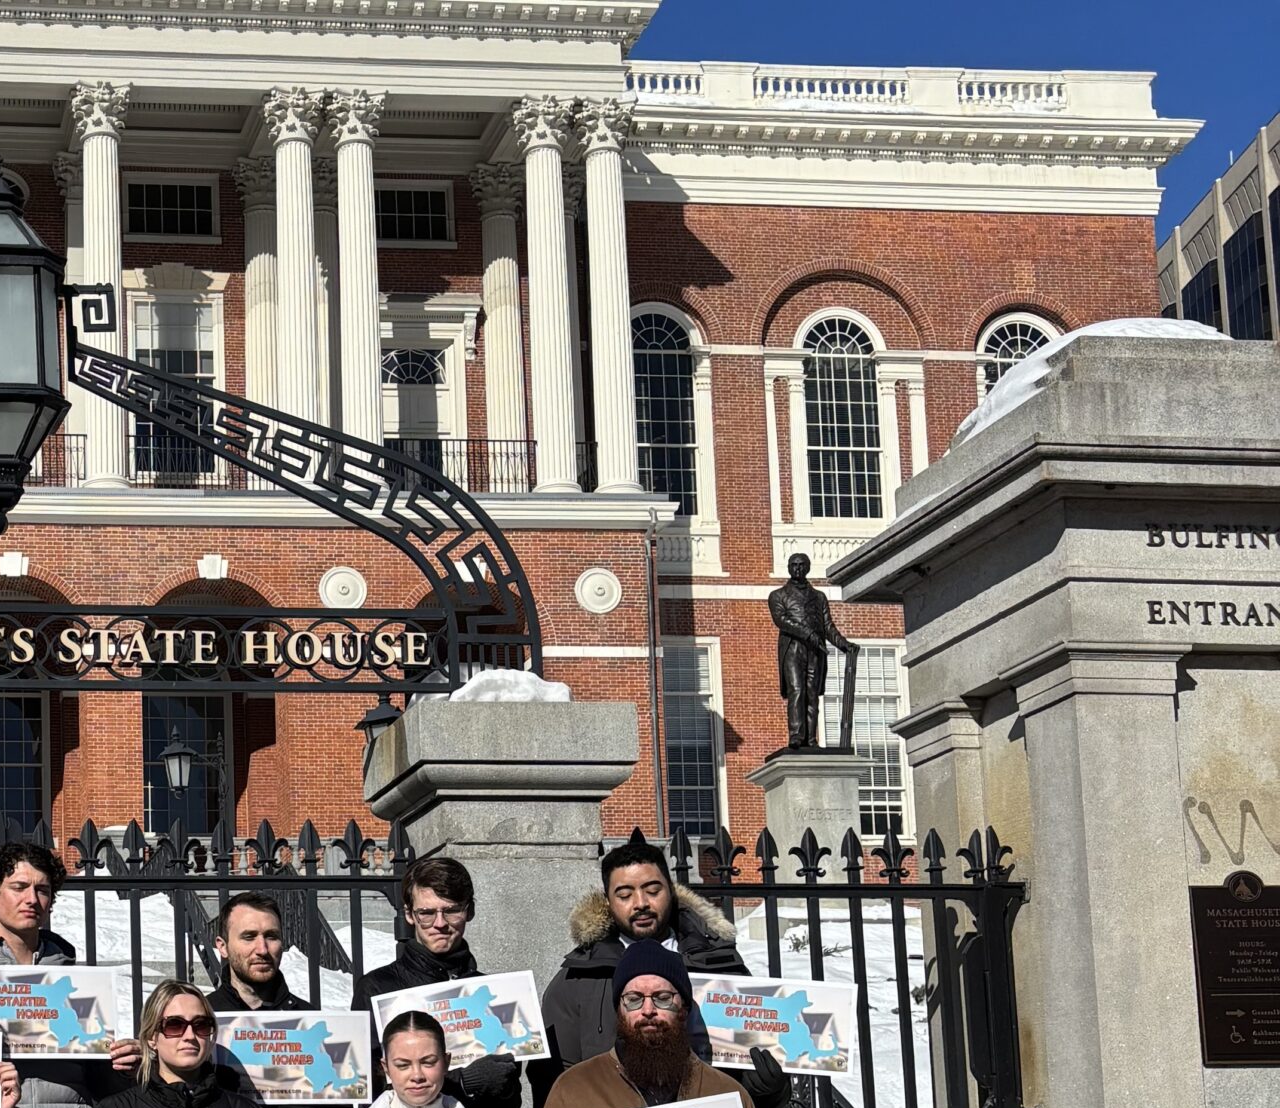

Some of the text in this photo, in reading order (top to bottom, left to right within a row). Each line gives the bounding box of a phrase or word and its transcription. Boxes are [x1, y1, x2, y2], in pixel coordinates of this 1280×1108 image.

[1145, 523, 1280, 550] BULFIN
[57, 628, 220, 666] STATE
[241, 630, 433, 667] HOUSE
[1215, 919, 1249, 928] STATE
[706, 993, 763, 1007] LEGALIZE
[16, 1008, 59, 1020] HOMES
[725, 1007, 778, 1020] STARTER
[744, 1021, 790, 1033] HOMES
[234, 1030, 287, 1041] LEGALIZE
[253, 1042, 302, 1053] STARTER
[271, 1054, 314, 1065] HOMES
